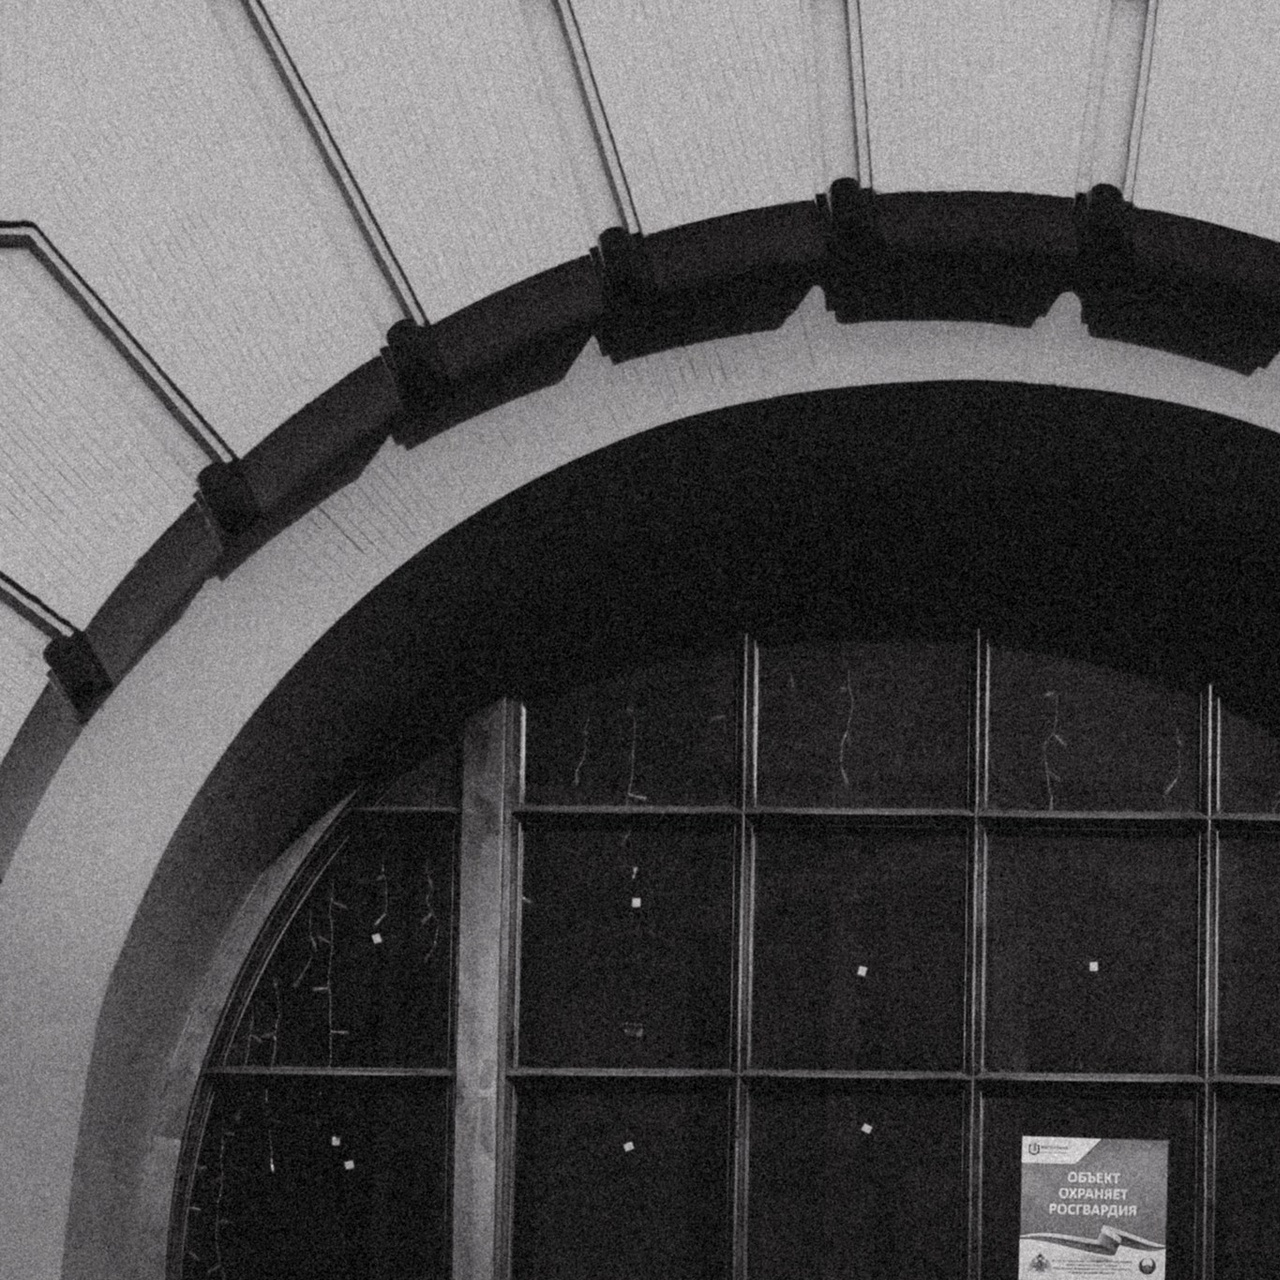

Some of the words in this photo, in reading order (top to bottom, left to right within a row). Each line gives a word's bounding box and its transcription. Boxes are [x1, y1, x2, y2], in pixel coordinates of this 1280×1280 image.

[1067, 1171, 1121, 1185] ОБЪЕКТ
[1058, 1187, 1129, 1201] ОХРАНЯЕТ
[1048, 1203, 1138, 1218] РОСГВАРДИЯ
